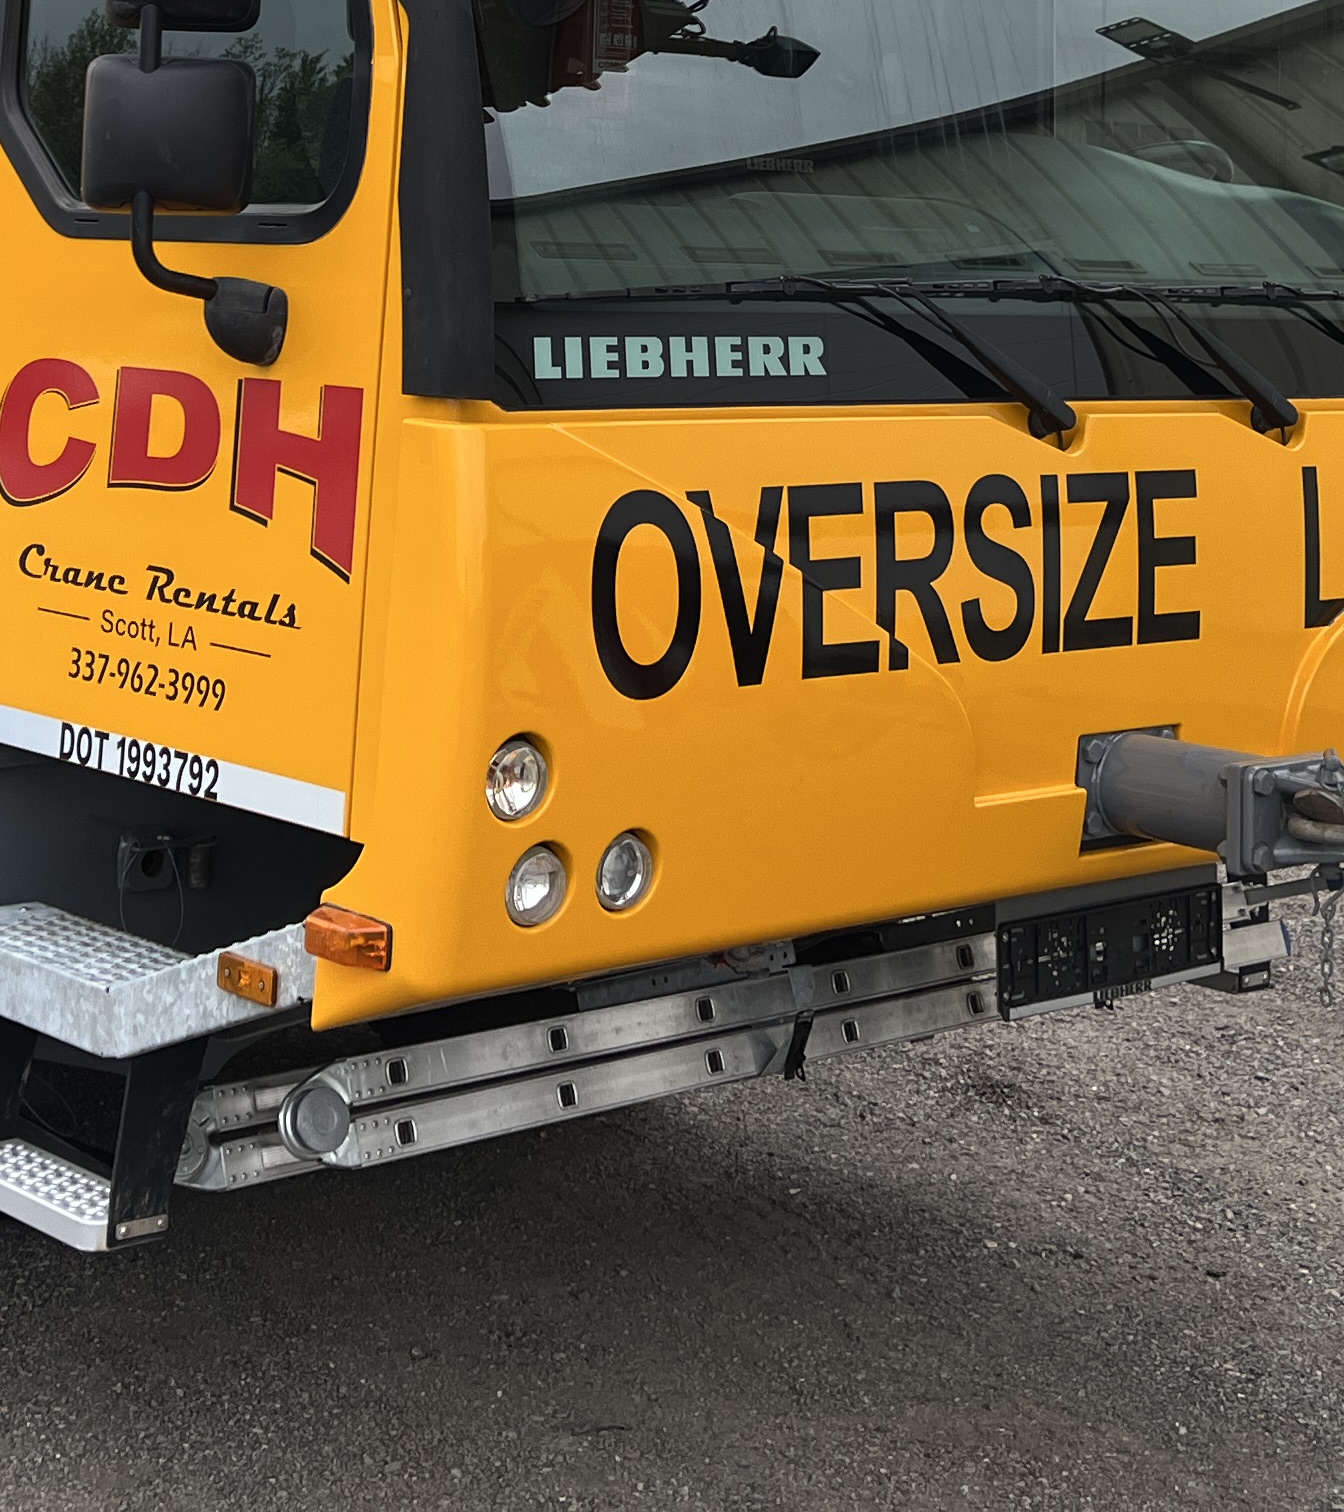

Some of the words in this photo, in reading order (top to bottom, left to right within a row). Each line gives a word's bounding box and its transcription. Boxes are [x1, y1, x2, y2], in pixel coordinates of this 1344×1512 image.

[746, 157, 815, 174] LIEBHERR
[532, 336, 827, 380] LIEBHERR
[18, 543, 128, 595] Crane
[145, 564, 302, 630] Rentals
[592, 468, 1201, 700] OVERSIZE
[100, 610, 162, 649] Scott,
[168, 622, 198, 651] LA
[67, 648, 227, 712] 337-962-3999
[60, 721, 110, 766] DOT
[116, 737, 219, 800] 1993792
